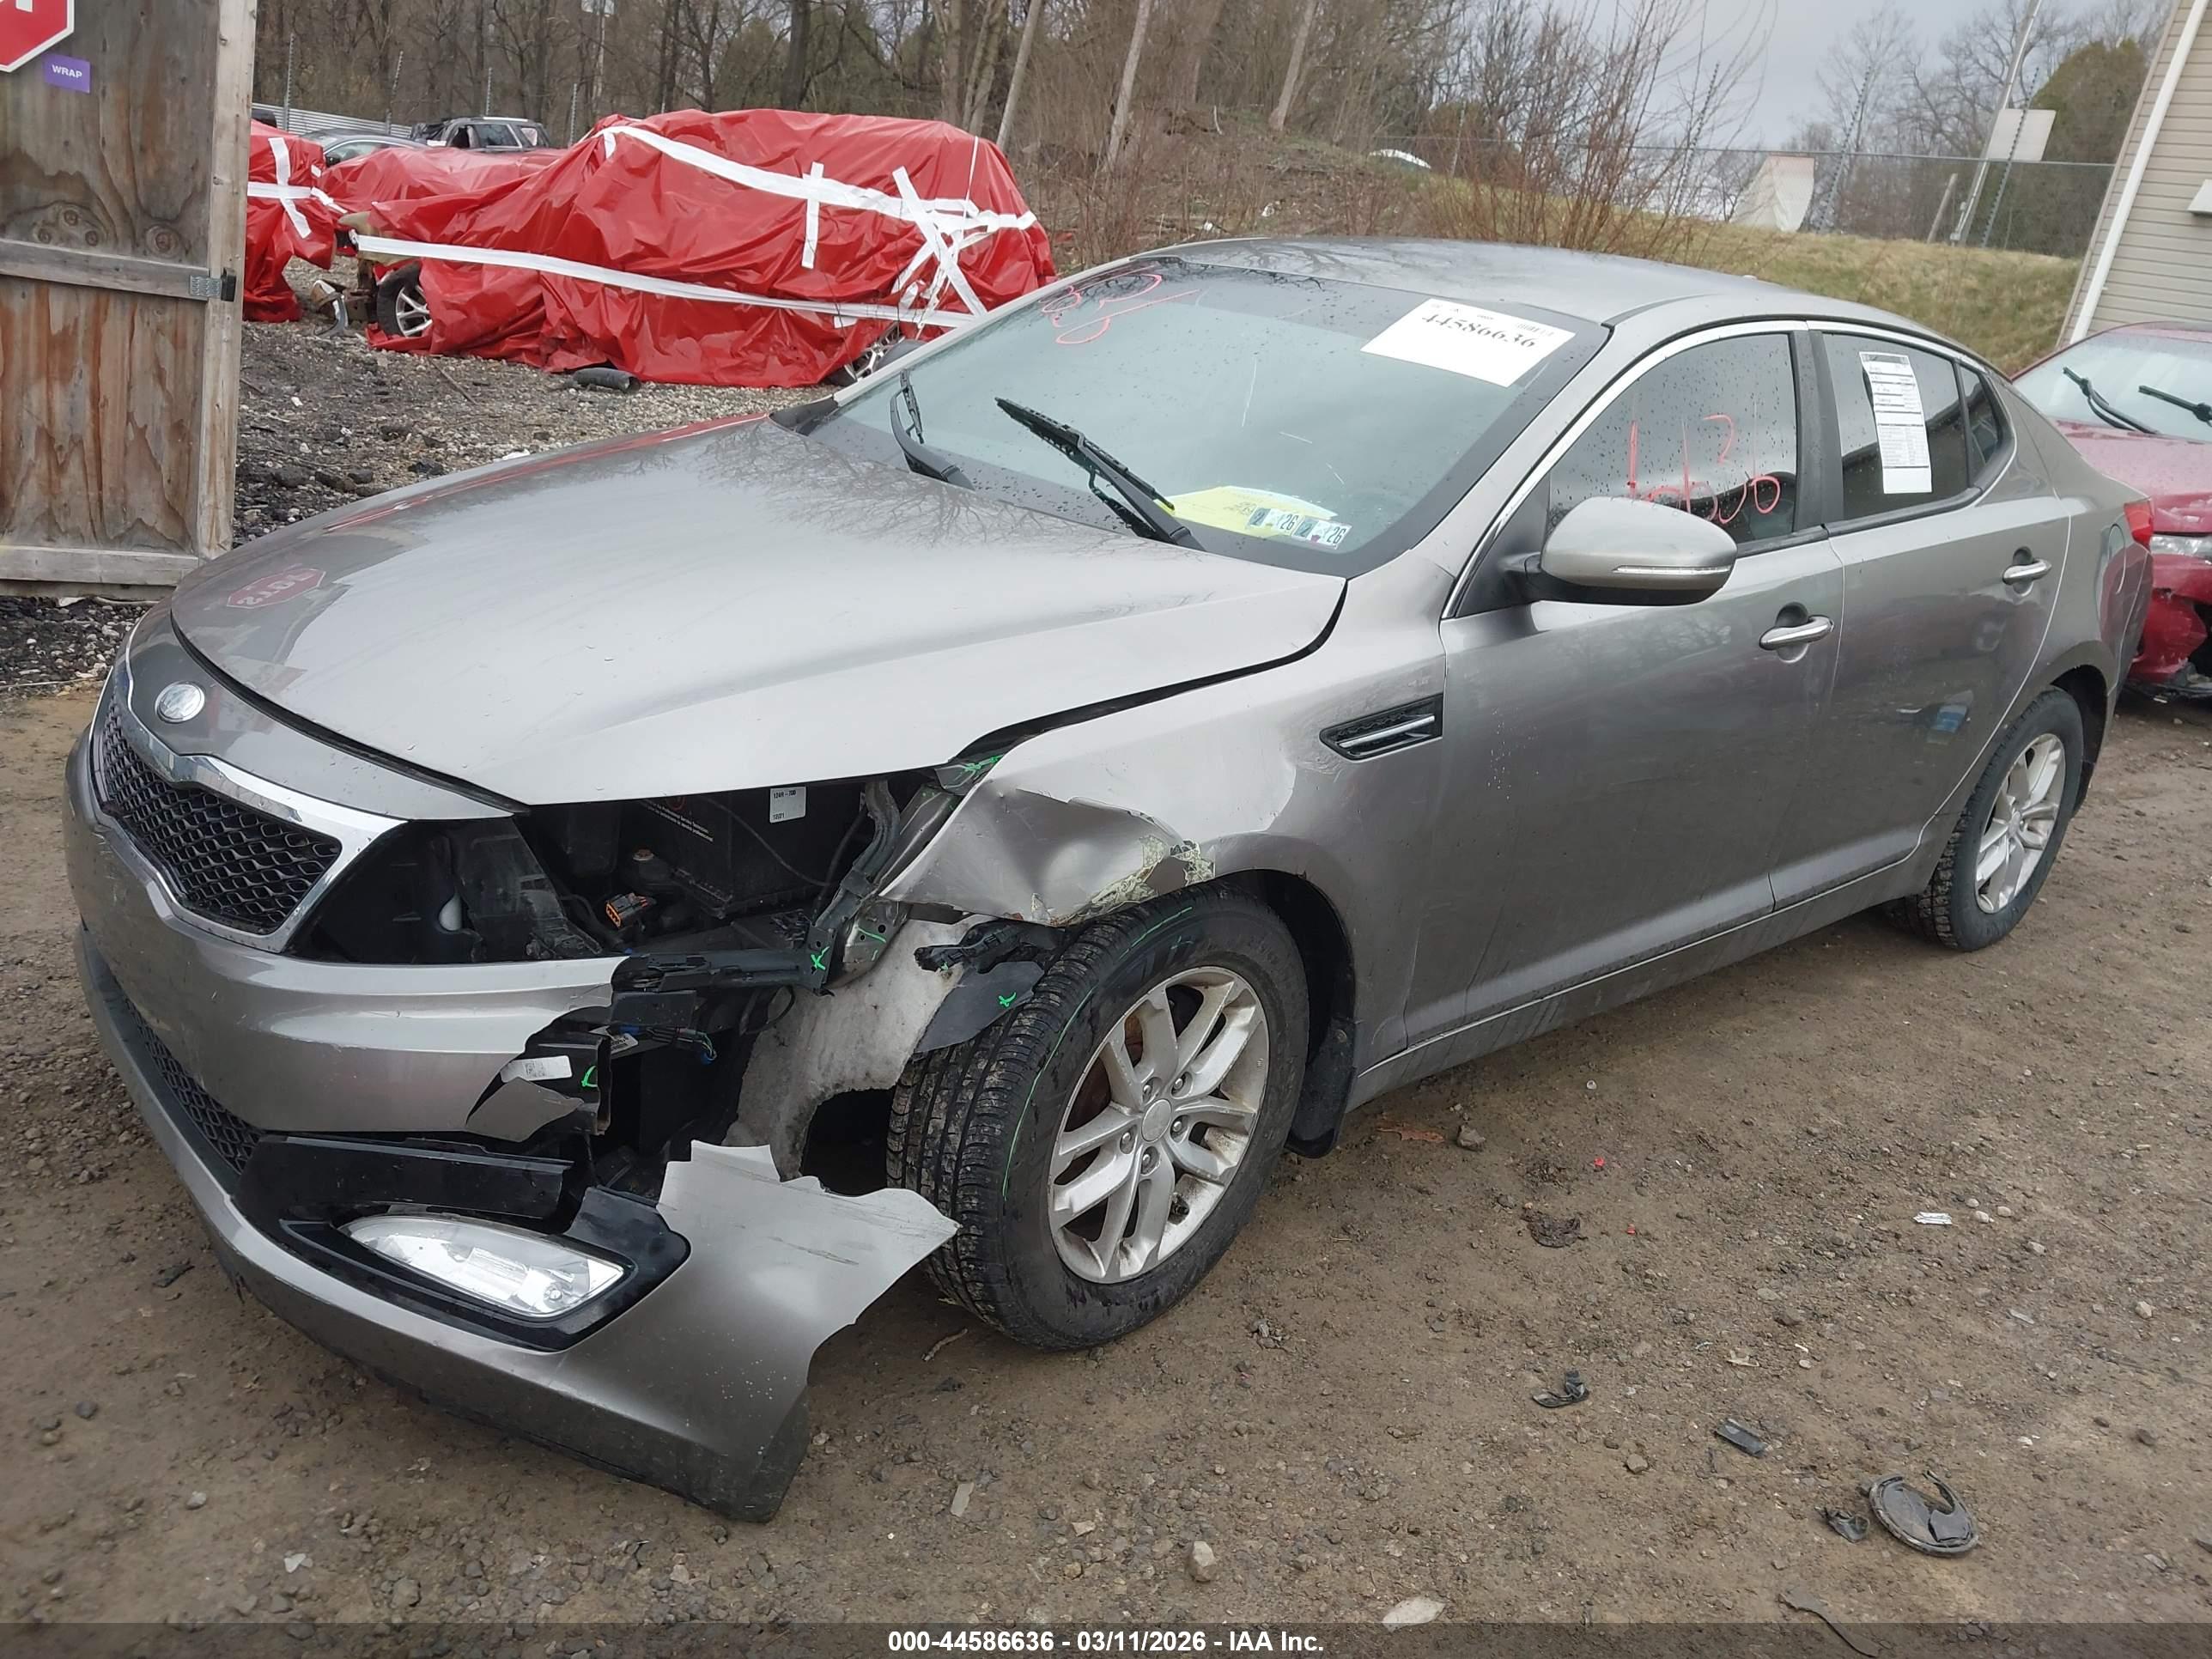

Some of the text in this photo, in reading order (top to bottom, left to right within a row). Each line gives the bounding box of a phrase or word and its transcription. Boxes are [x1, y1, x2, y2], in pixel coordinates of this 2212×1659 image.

[52, 64, 82, 79] WRAP
[1279, 513, 1299, 532] 26
[1326, 526, 1348, 544] 26
